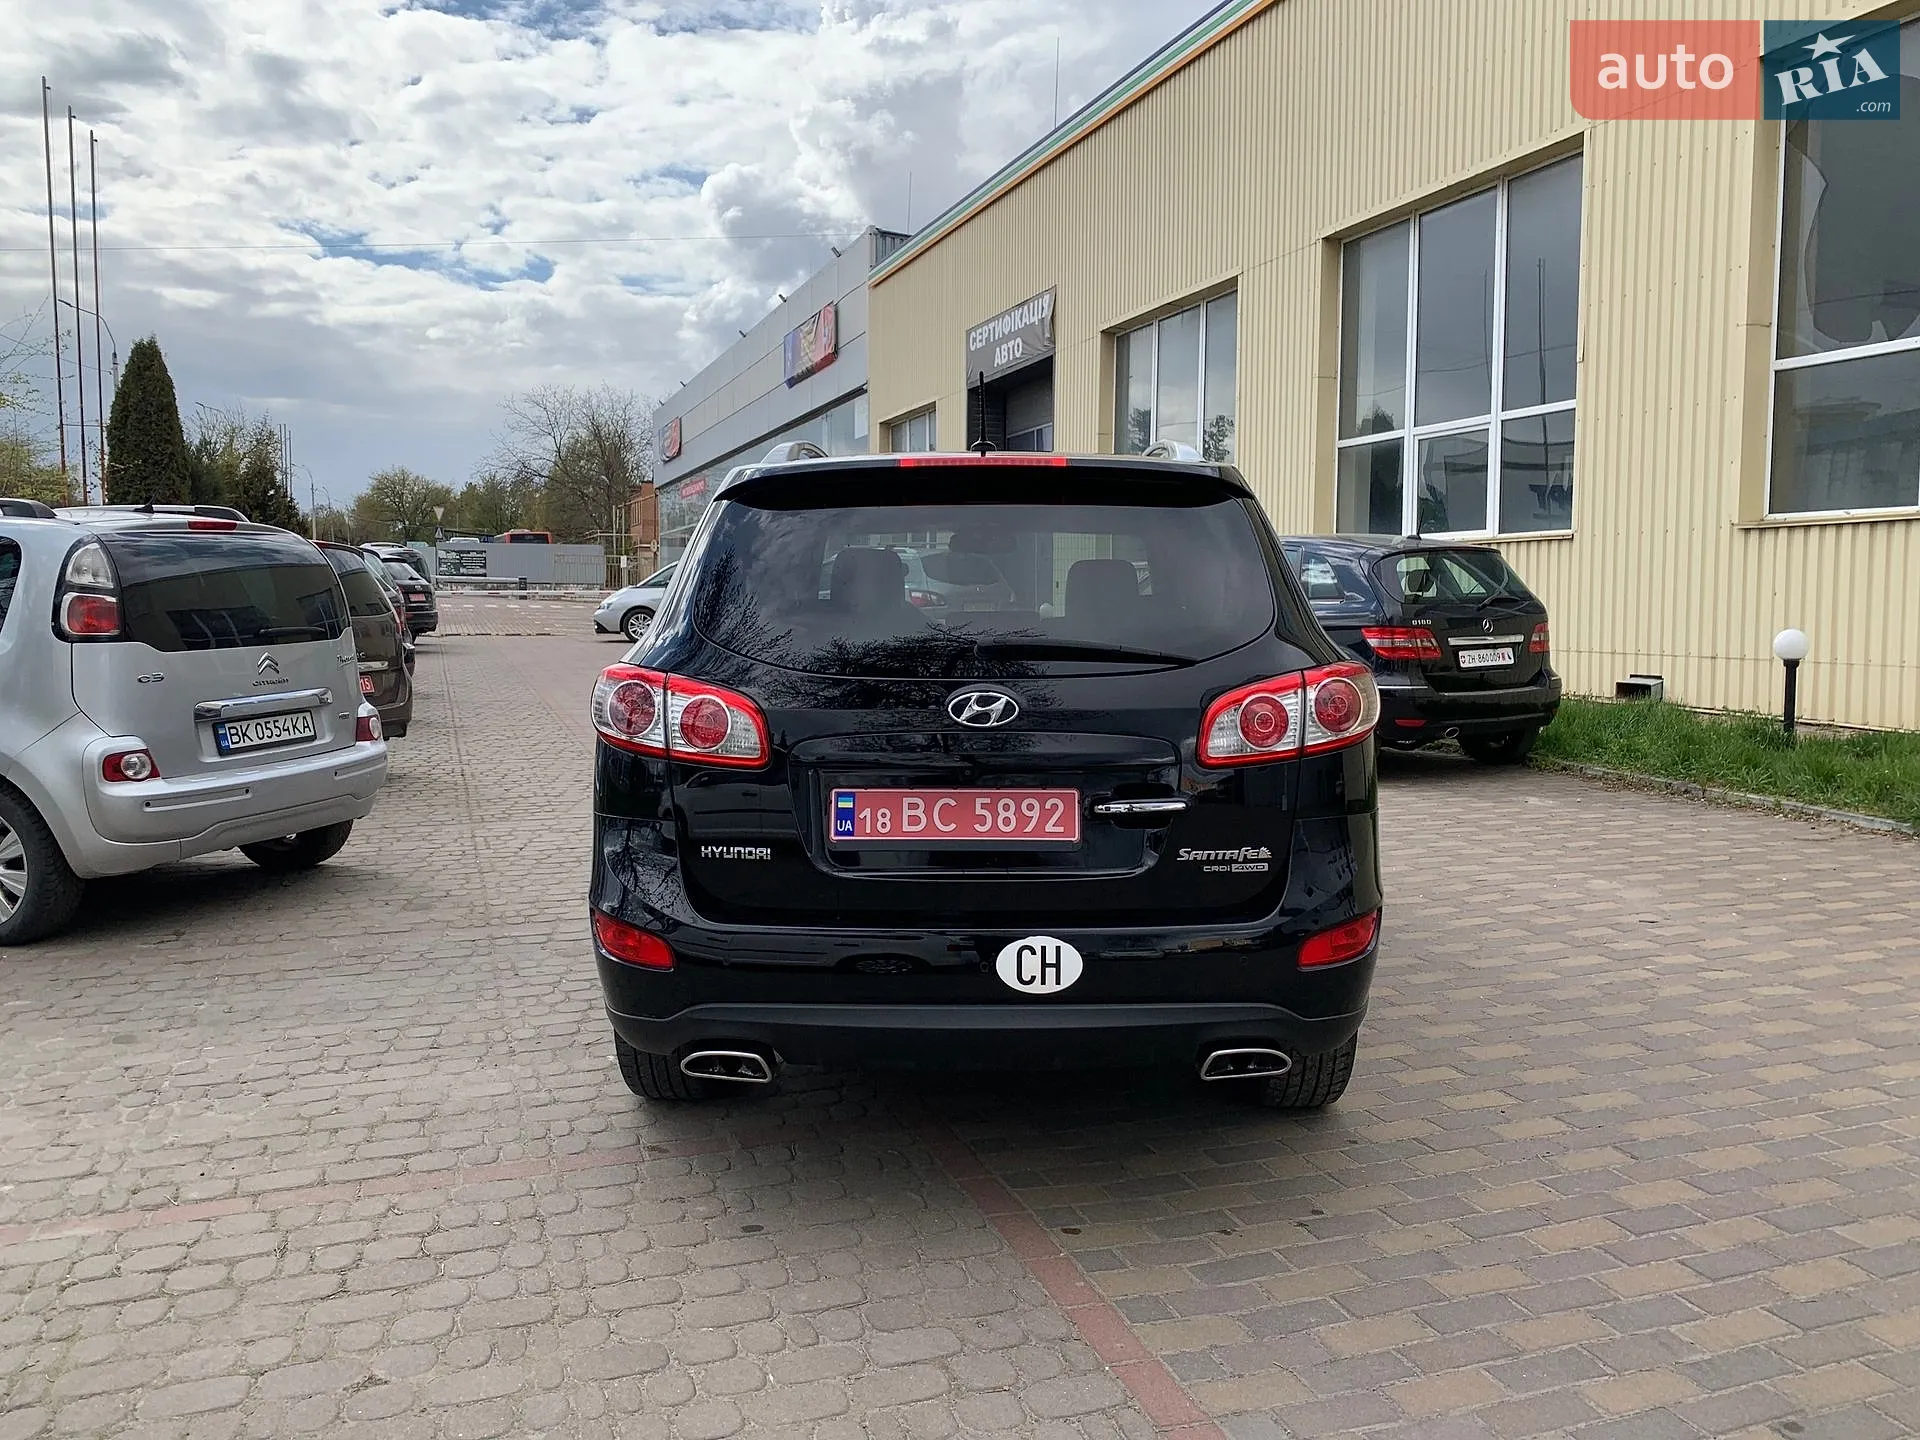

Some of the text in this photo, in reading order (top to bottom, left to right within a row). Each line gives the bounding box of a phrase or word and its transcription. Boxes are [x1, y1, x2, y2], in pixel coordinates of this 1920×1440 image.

[969, 293, 1050, 352] СЕРТИФІКАЦІЯ
[994, 337, 1022, 367] АВТО
[136, 672, 165, 683] C3
[837, 819, 853, 832] UA
[858, 797, 1065, 834] 18 BC 5892
[701, 845, 771, 860] HYUNDAI
[1016, 944, 1062, 986] CH
